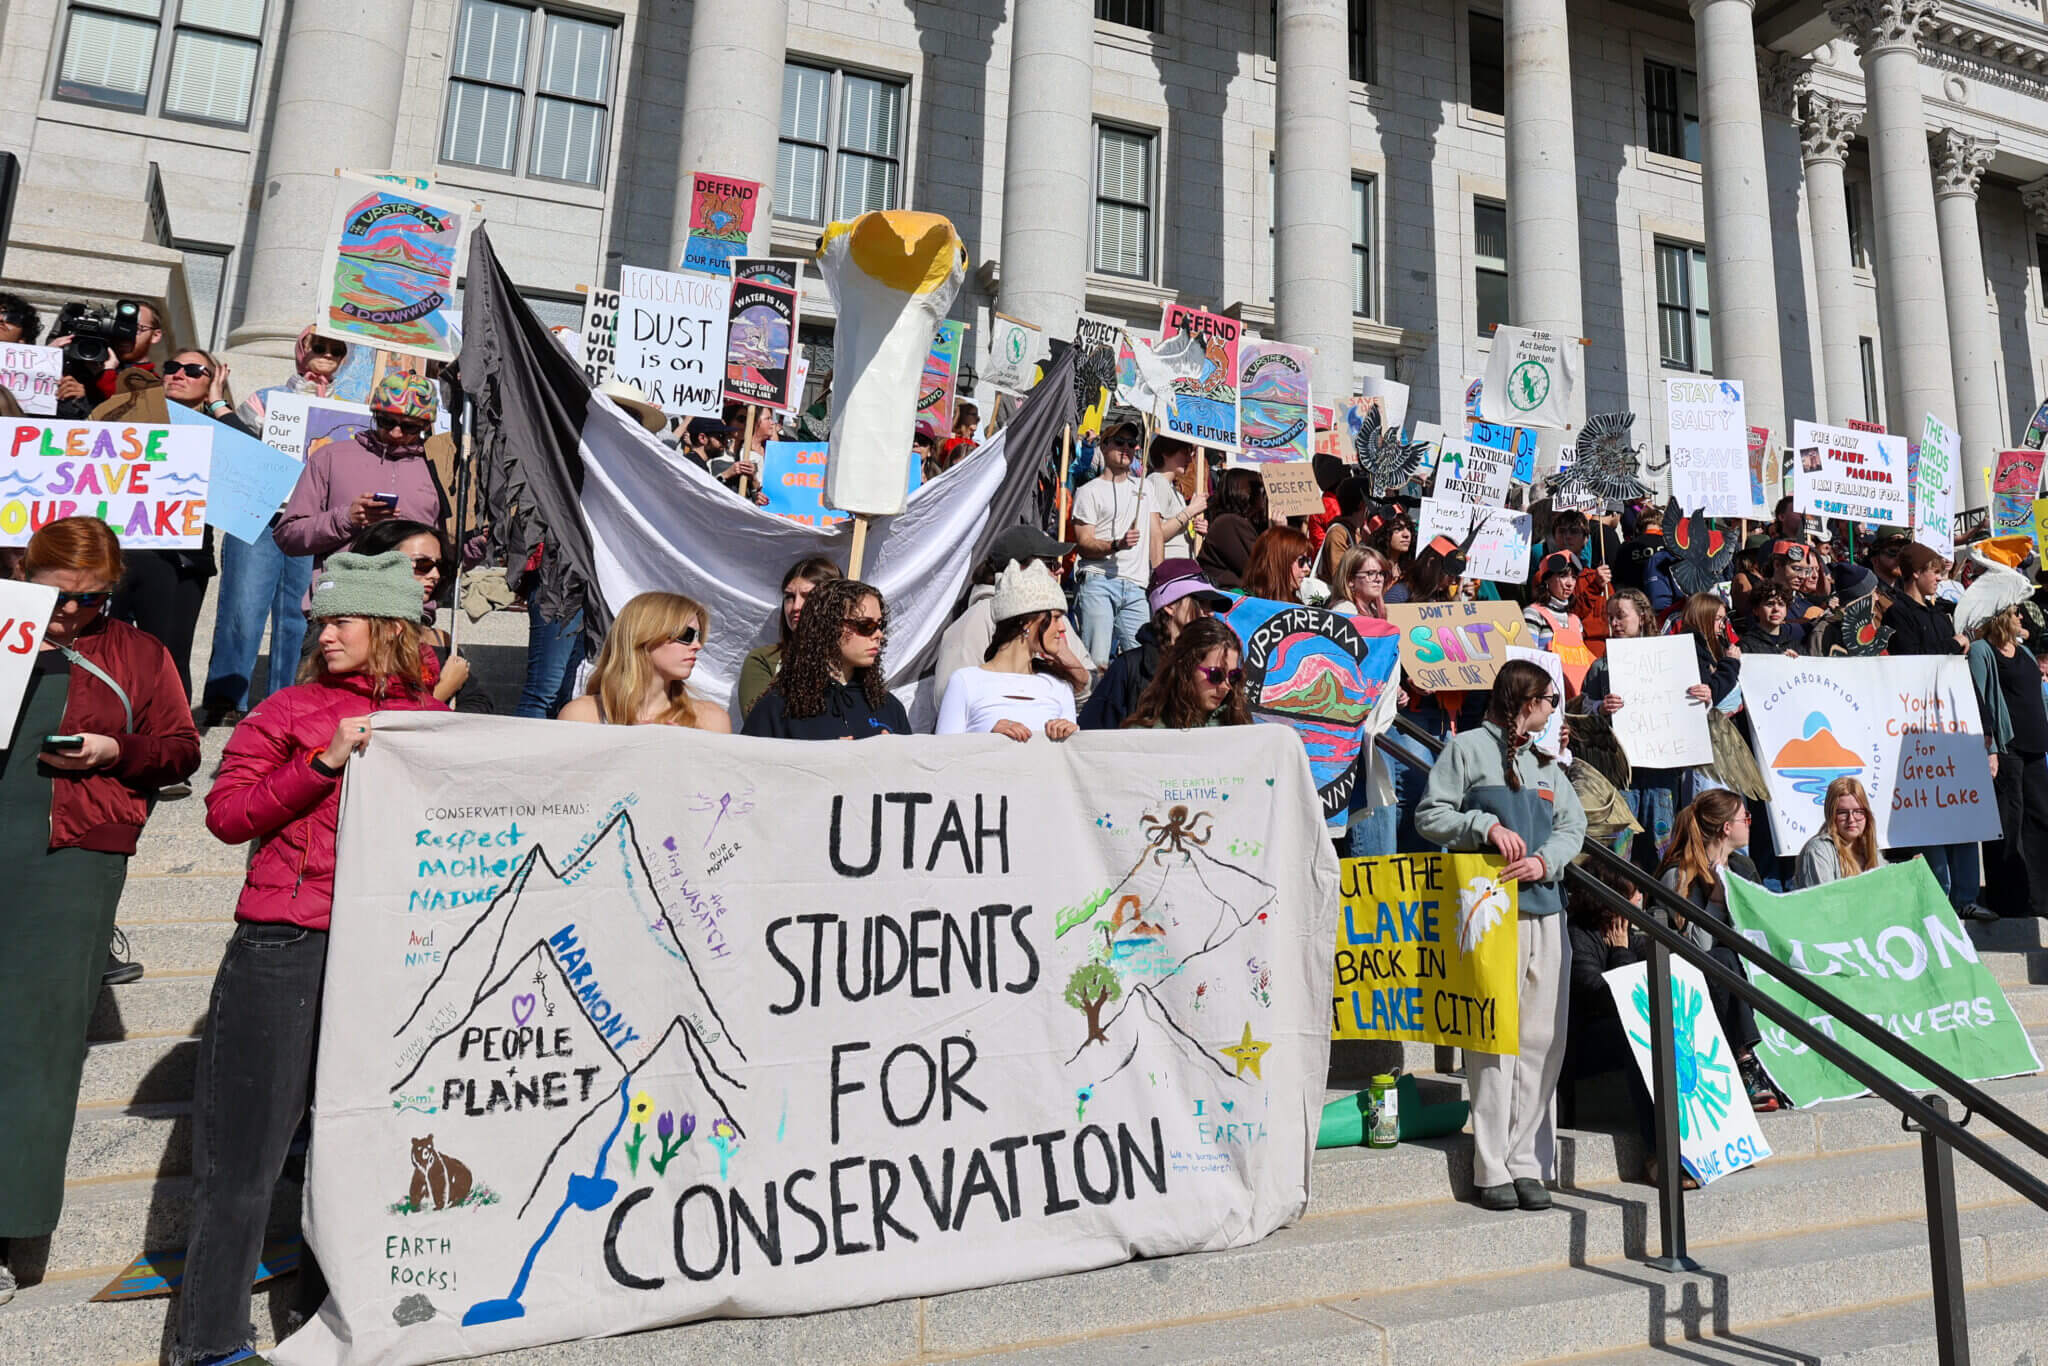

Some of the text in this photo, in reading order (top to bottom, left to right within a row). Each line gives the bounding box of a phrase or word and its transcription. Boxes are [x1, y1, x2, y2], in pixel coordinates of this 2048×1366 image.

[695, 180, 753, 200] DEFEND
[361, 203, 441, 233] UPSTREAM
[685, 253, 706, 265] OUR
[594, 292, 619, 310] HO
[622, 270, 723, 311] LEGISLATORS
[357, 295, 441, 323] DOWNWIND
[735, 292, 791, 316] WATER IS LIFE
[588, 332, 617, 348] WIL
[634, 308, 712, 351] DUST
[1076, 316, 1119, 345] PROTECT
[1520, 340, 1557, 352] Act before
[641, 347, 704, 374] is on
[1249, 353, 1300, 373] UPSTREAM
[673, 379, 723, 413] HANDS!
[731, 379, 758, 390] DEFEND
[1671, 383, 1717, 403] STAY
[271, 410, 301, 423] Save
[1671, 409, 1734, 431] SALTY
[268, 426, 291, 437] Our
[1169, 419, 1237, 443] OUR FUTURE
[1252, 421, 1306, 448] DOWNWIND
[1810, 430, 1859, 449] THE ONLY
[1926, 415, 1943, 444] THE
[10, 425, 170, 462] PLEASE
[267, 440, 300, 454] Great
[1469, 445, 1515, 467] INSTREAM
[1921, 439, 1949, 473] BIRDS
[46, 461, 151, 495] SAVE
[1464, 470, 1487, 484] ARE
[1467, 458, 1497, 475] FLOWS
[1846, 466, 1892, 484] PAGANDA
[1918, 460, 1943, 490] NEED
[1269, 481, 1313, 495] DESERT
[1445, 478, 1501, 500] BENEFICIAL
[1687, 470, 1729, 493] THE
[1812, 479, 1876, 499] I AM FALLING
[1686, 494, 1738, 516] LAKE
[1917, 482, 1935, 509] THE
[97, 499, 207, 536] LAKE
[1923, 506, 1948, 537] LAKE
[1484, 557, 1521, 577] Lake
[1418, 602, 1477, 620] DON'T BE
[1250, 608, 1360, 669] UPSTREAM
[1409, 620, 1522, 664] SALTY
[1417, 667, 1456, 689] SAVE
[1458, 664, 1487, 685] OUR
[1763, 671, 1860, 712] COLLABORATION
[1899, 691, 1945, 713] Youth
[1886, 713, 1968, 737] Coalition
[1915, 738, 1936, 757] for
[1903, 755, 1956, 780] Great
[1164, 787, 1218, 801] RELATIVE
[1891, 785, 1980, 811] Salt Lake
[425, 802, 591, 821] CONSERVATION MEANS:
[415, 821, 528, 853] Respect
[829, 792, 1010, 878] UTAH
[705, 841, 743, 877] MOTHER
[708, 842, 728, 862] OUR
[418, 854, 525, 879] Mother
[1340, 856, 1444, 899] UT THE
[408, 884, 500, 912] NATURE
[709, 893, 729, 919] the
[680, 879, 732, 961] WASATCH
[1344, 901, 1440, 945] LAKE
[408, 929, 434, 947] Ava!
[405, 950, 442, 967] NATE
[764, 903, 1041, 1016] STUDENTS
[1335, 946, 1447, 986] BACK IN
[549, 922, 641, 1051] HARMONY
[1352, 987, 1425, 1032] LAKE
[1434, 989, 1497, 1040] CITY!
[457, 1027, 574, 1062] PEOPLE
[441, 1064, 601, 1116] PLANET
[830, 1035, 988, 1145] FOR
[1192, 1099, 1209, 1117] I
[1695, 1134, 1774, 1183] SAVE GSL
[603, 1117, 1168, 1290] CONSERVATION
[386, 1235, 453, 1260] EARTH
[391, 1266, 457, 1293] ROCKS!
